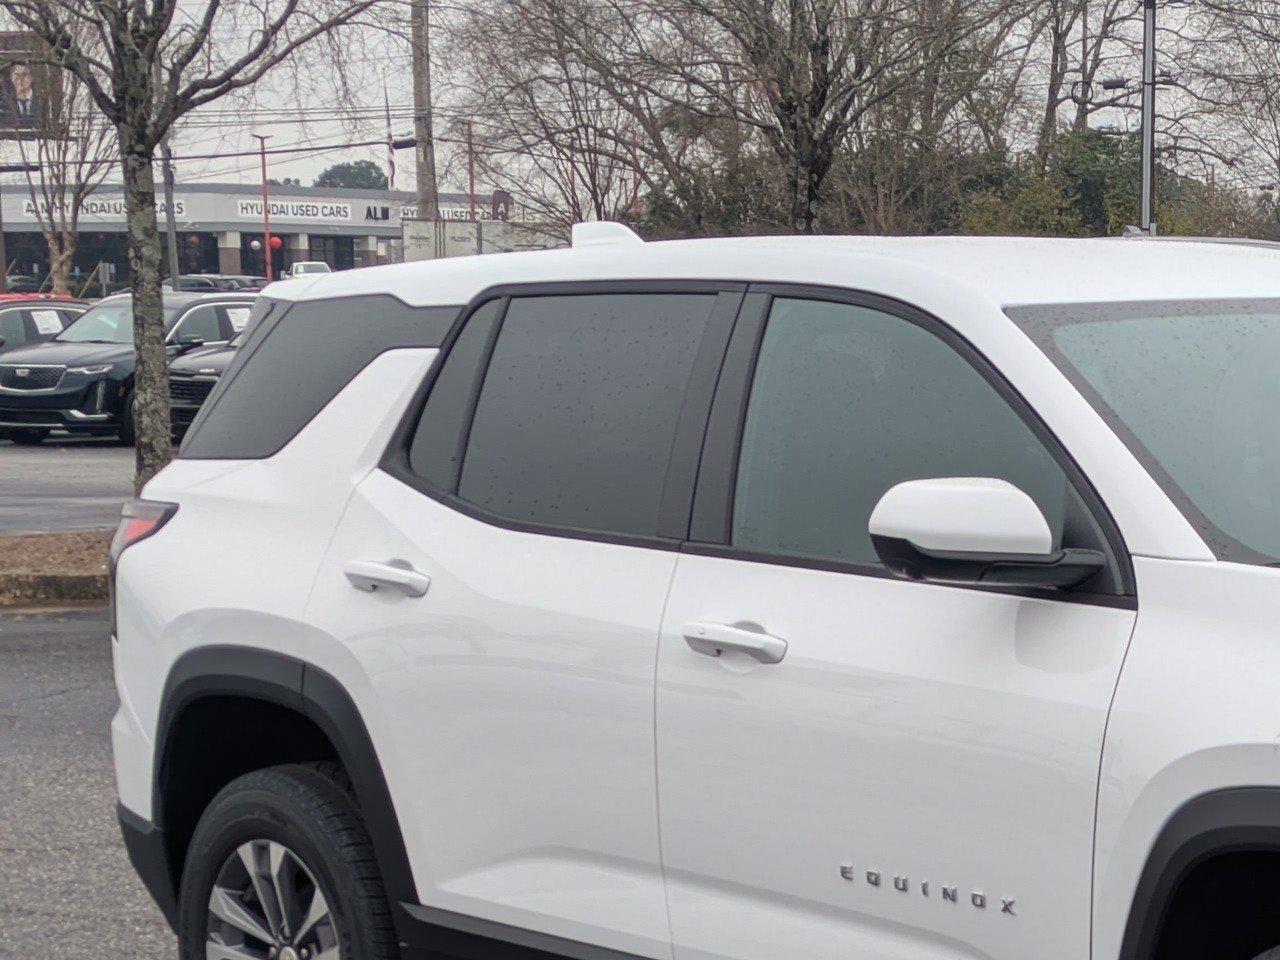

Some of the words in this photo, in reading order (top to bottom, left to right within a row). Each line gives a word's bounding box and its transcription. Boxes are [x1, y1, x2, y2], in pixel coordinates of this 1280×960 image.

[25, 202, 50, 214] AM
[54, 202, 111, 214] HYNDAI
[152, 203, 184, 214] CAS
[292, 205, 319, 216] USED
[321, 206, 348, 217] CARS
[840, 862, 1016, 915] EQUINOX
